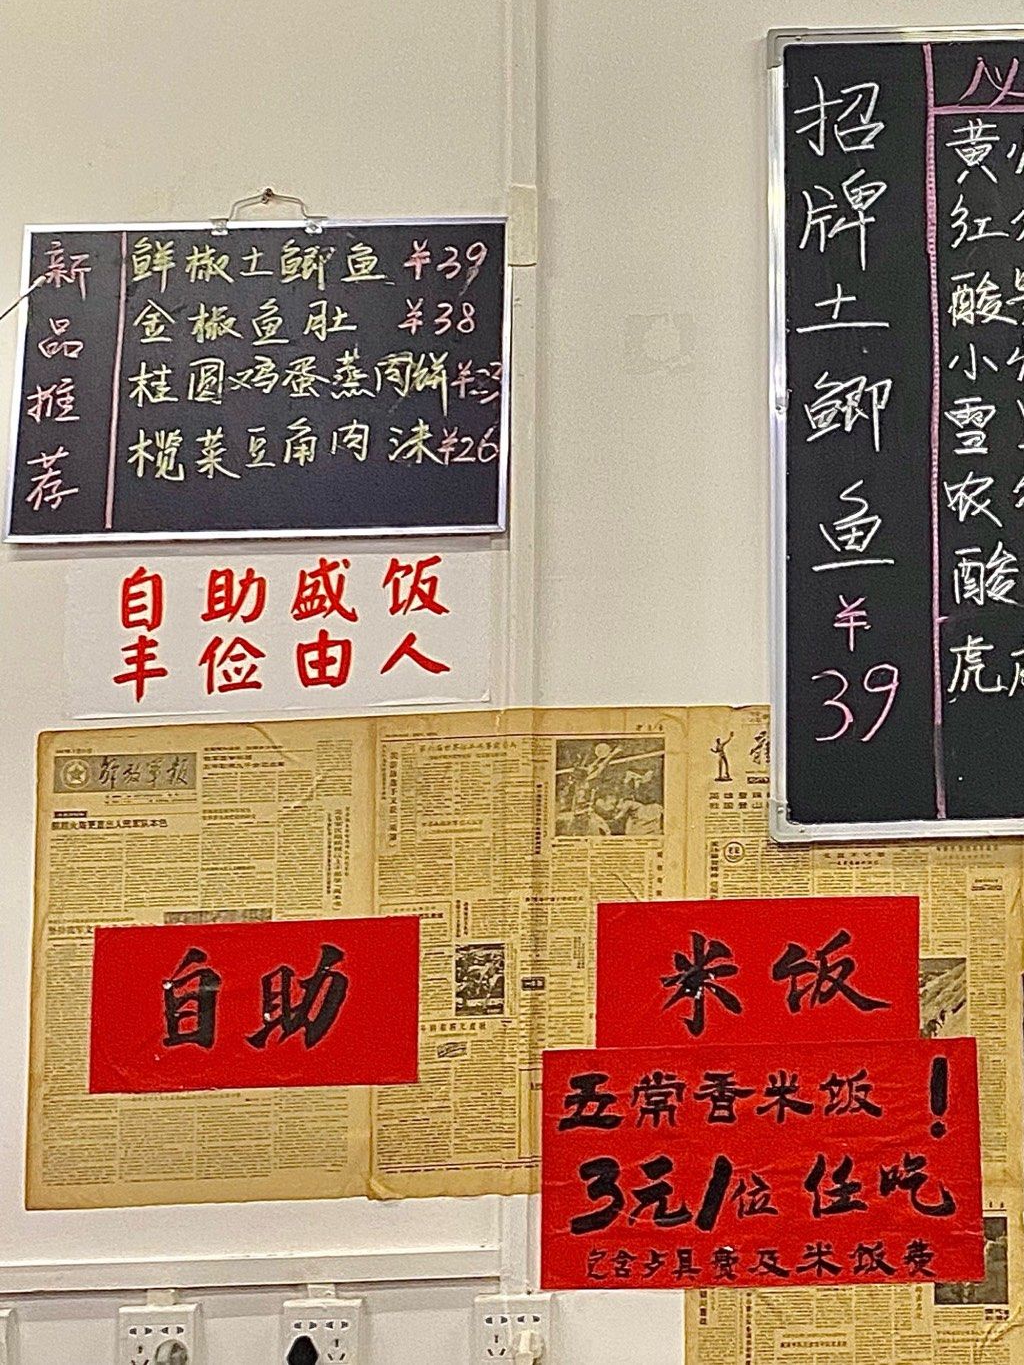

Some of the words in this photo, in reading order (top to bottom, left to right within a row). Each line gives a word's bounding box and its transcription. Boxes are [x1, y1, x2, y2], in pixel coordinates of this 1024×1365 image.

[131, 236, 386, 294] 鲜椒土鲫鱼
[132, 297, 359, 346] 金椒鱼肚
[794, 75, 896, 572] 招牌土鲫鱼
[26, 239, 92, 511] 新品推荐
[120, 554, 450, 632] 自助盛饭
[112, 629, 451, 703] 丰俭由人
[162, 942, 350, 1049] 自助
[660, 929, 892, 1036] 米饭
